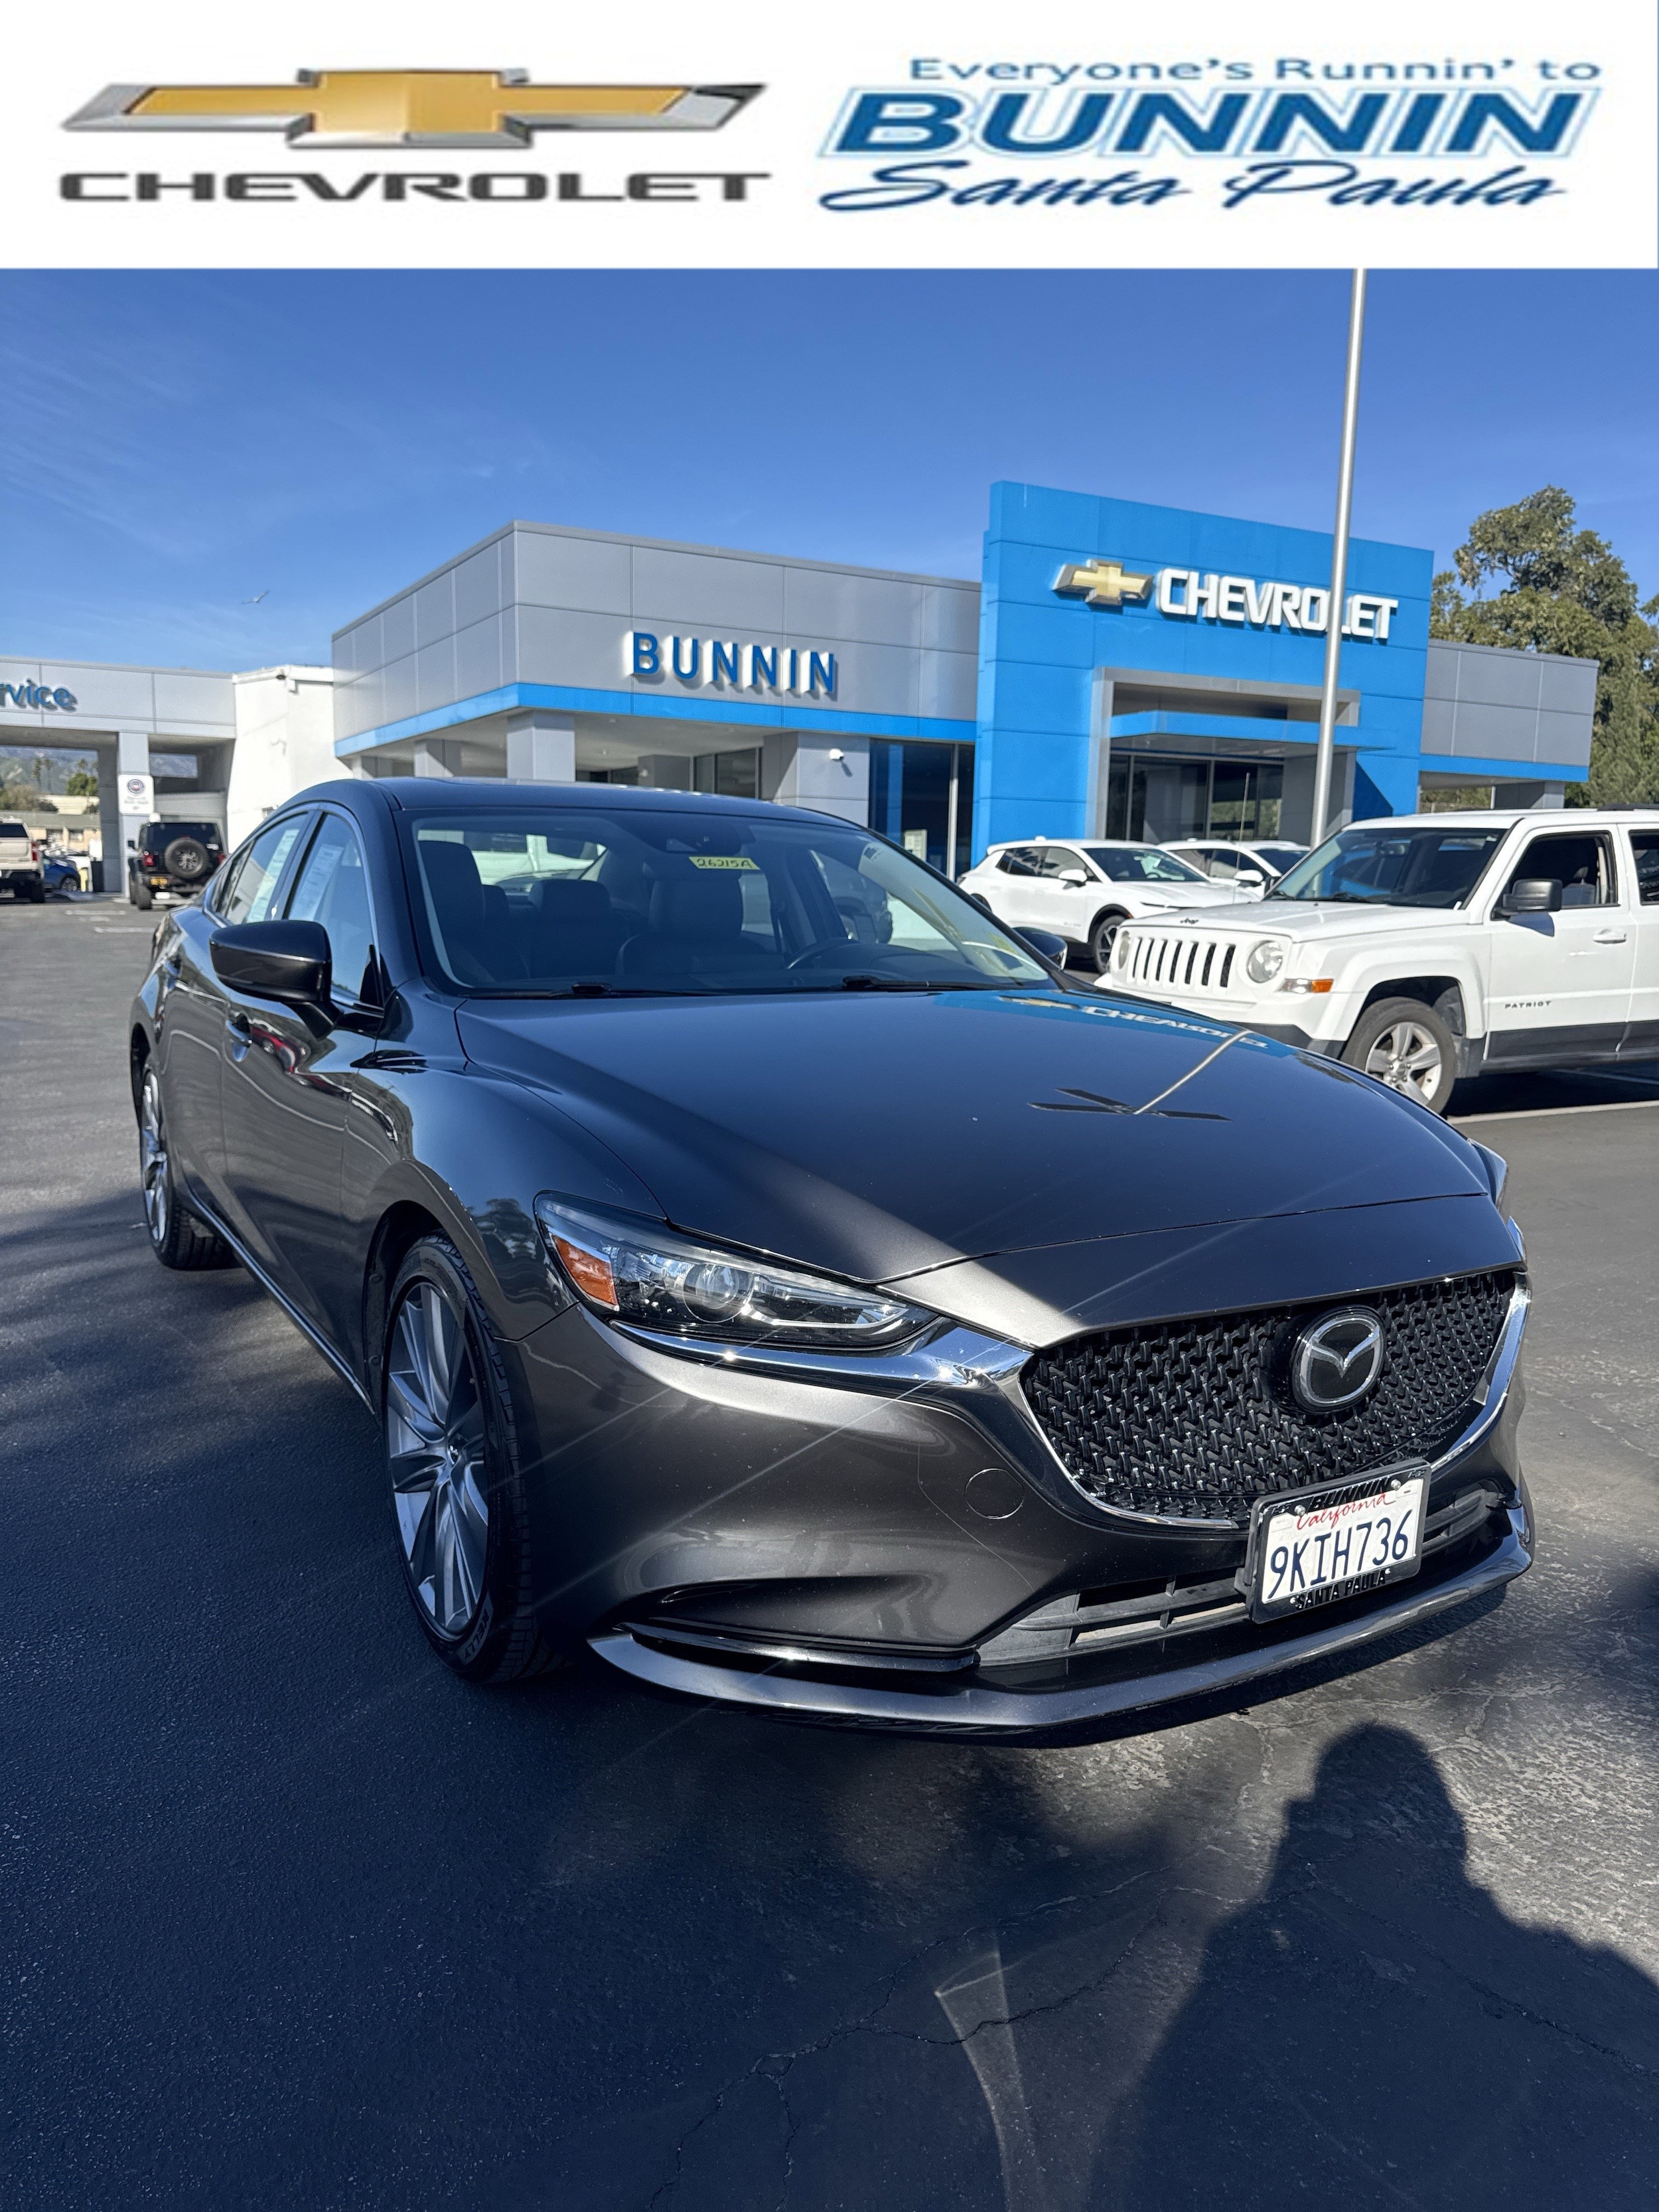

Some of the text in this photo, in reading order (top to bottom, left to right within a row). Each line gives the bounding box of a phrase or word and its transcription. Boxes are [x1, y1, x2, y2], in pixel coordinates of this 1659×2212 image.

[1155, 568, 1399, 640] CHEVROET
[626, 630, 837, 696] BUNNIN
[1504, 1000, 1551, 1009] PATRIOT
[1297, 1492, 1397, 1530] California
[1267, 1509, 1412, 1600] 9KIH736
